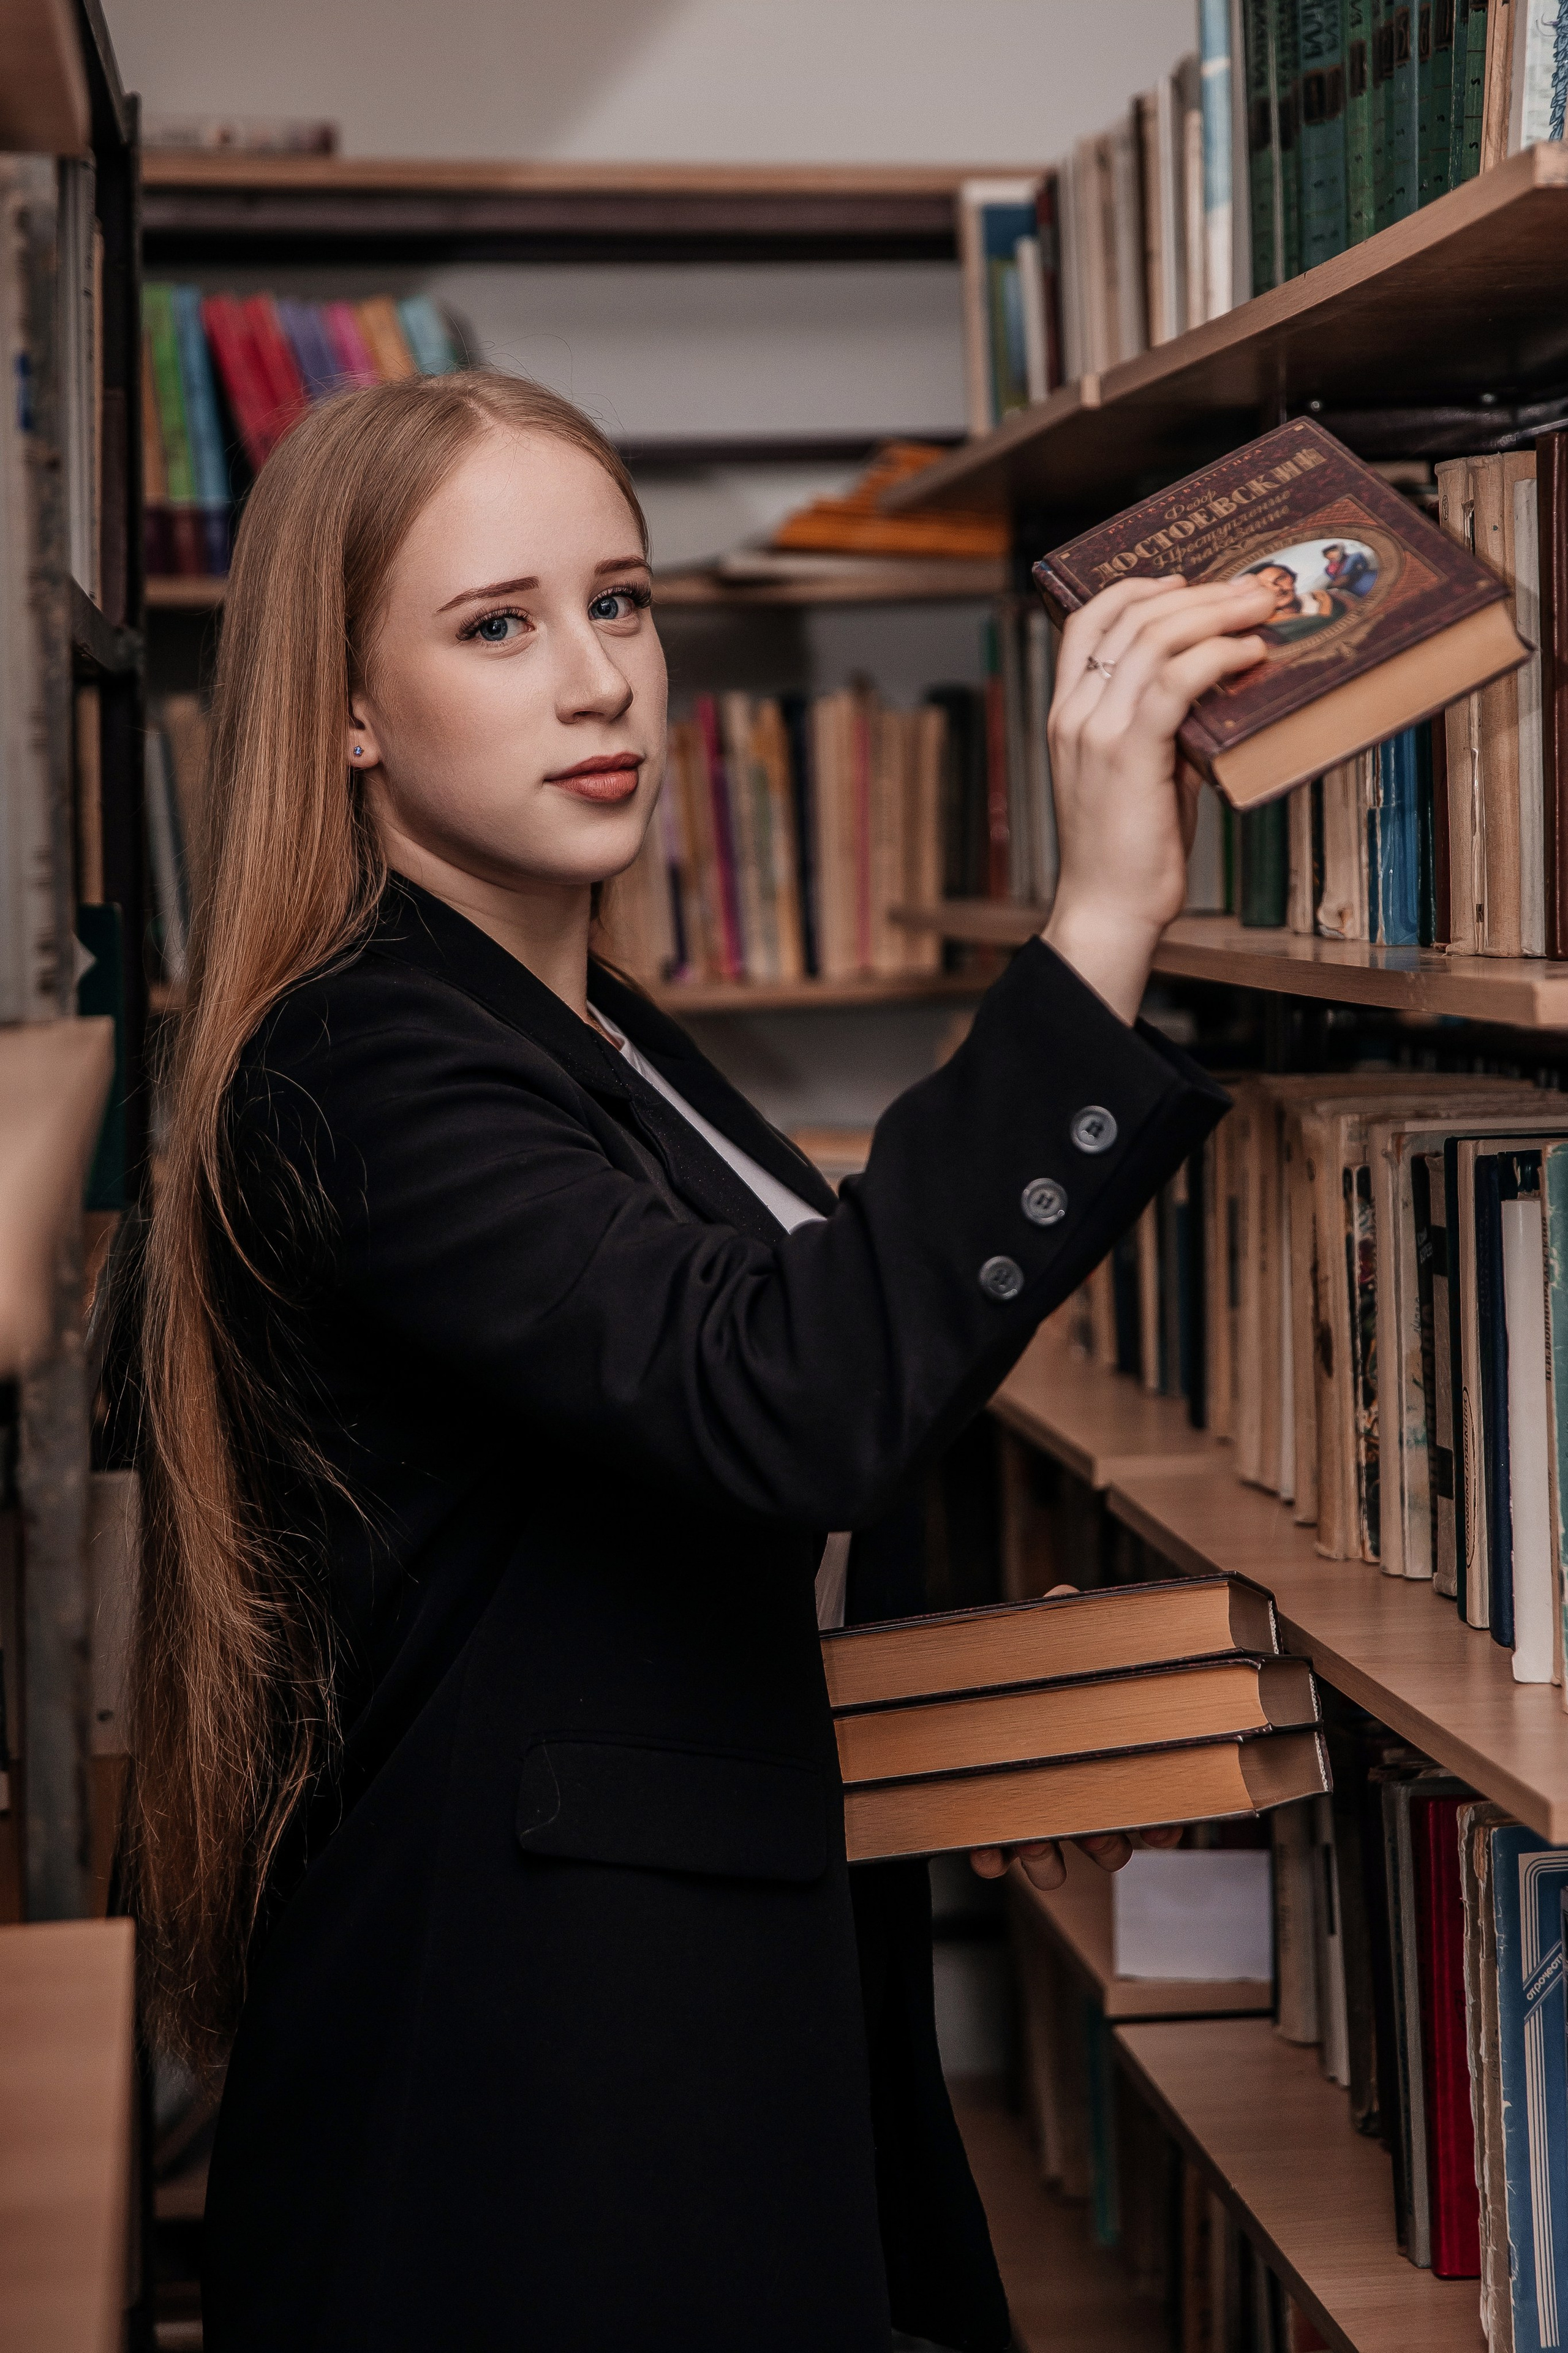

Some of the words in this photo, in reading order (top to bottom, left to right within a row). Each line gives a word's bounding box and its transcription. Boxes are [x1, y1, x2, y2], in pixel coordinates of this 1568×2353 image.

[1090, 447, 1328, 588] ДОСТОЕВСКИЙ
[1153, 490, 1291, 569] Преступление
[1164, 489, 1216, 520] Федор
